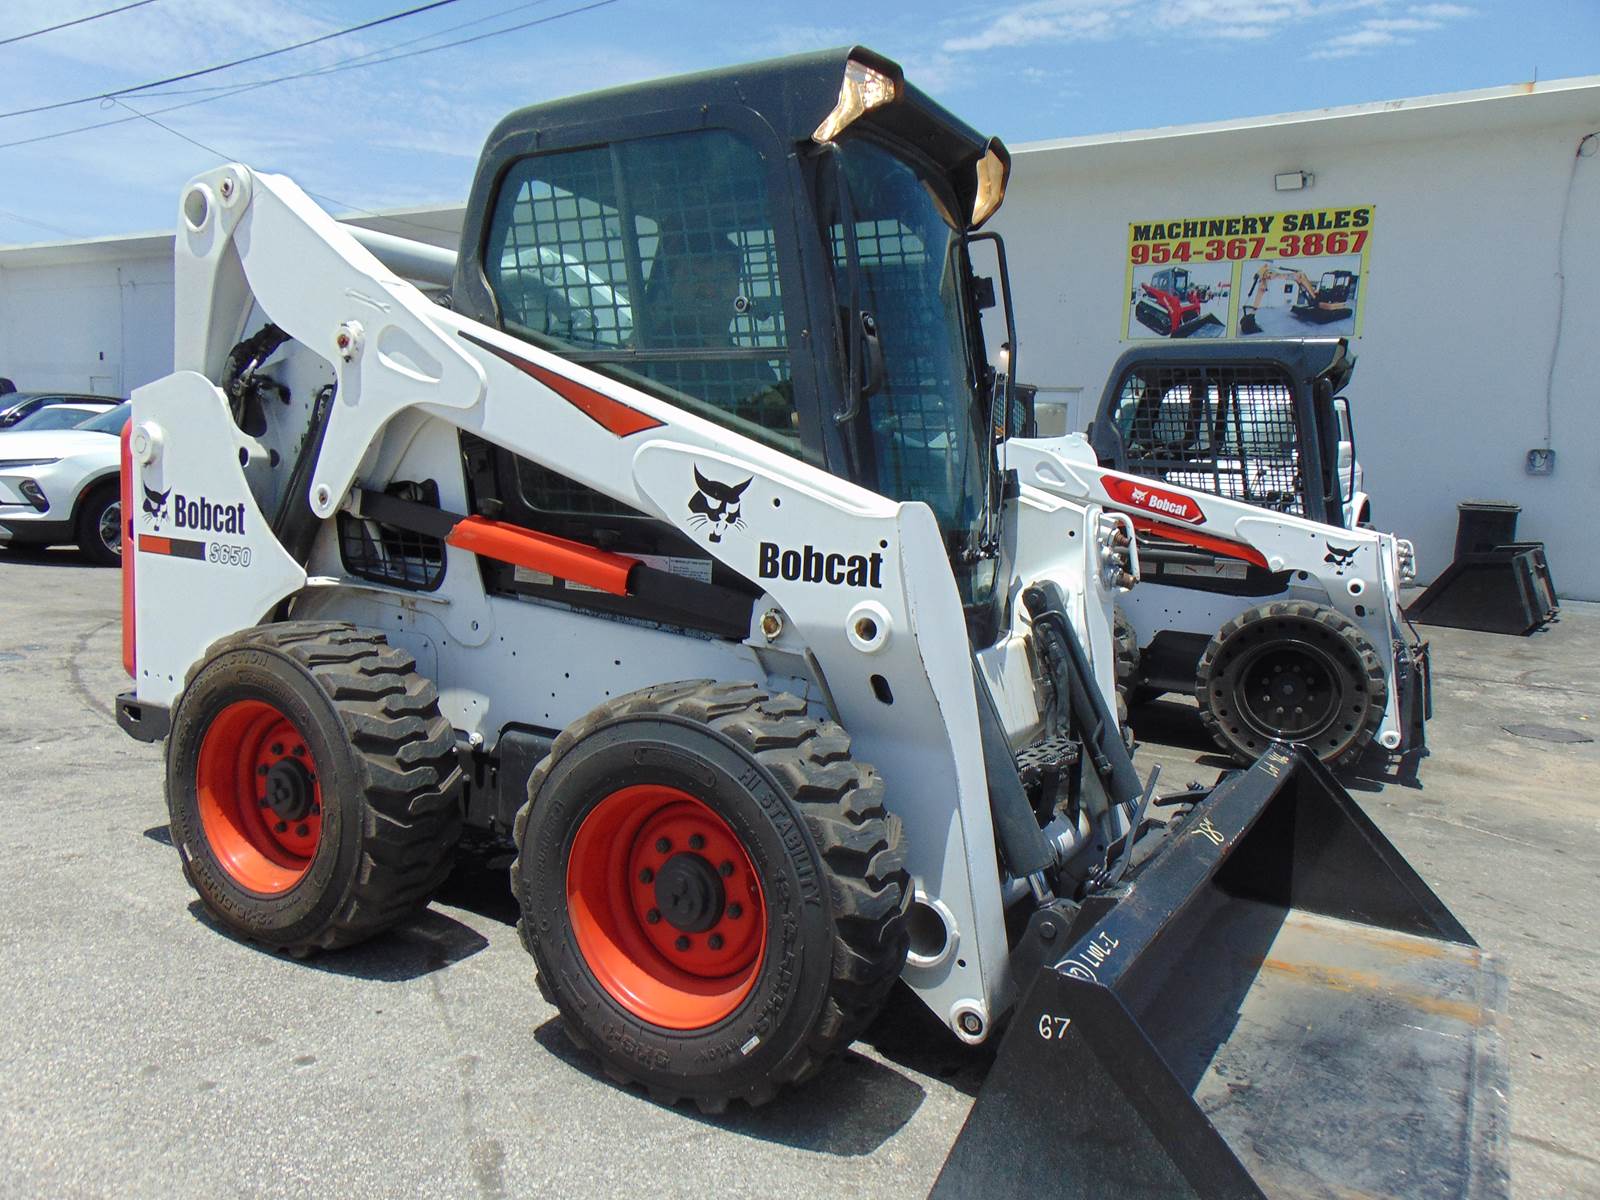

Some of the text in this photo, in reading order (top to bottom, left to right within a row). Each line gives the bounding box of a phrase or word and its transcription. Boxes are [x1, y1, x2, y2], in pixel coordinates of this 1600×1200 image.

[1133, 208, 1370, 242] MACHINERY SALES
[1130, 230, 1369, 265] 954-367-3867
[174, 494, 246, 536] Bobcat
[1148, 495, 1188, 516] Bobcat
[209, 542, 252, 568] S650
[758, 541, 883, 589] Bobcat
[1038, 1013, 1071, 1040] 67
